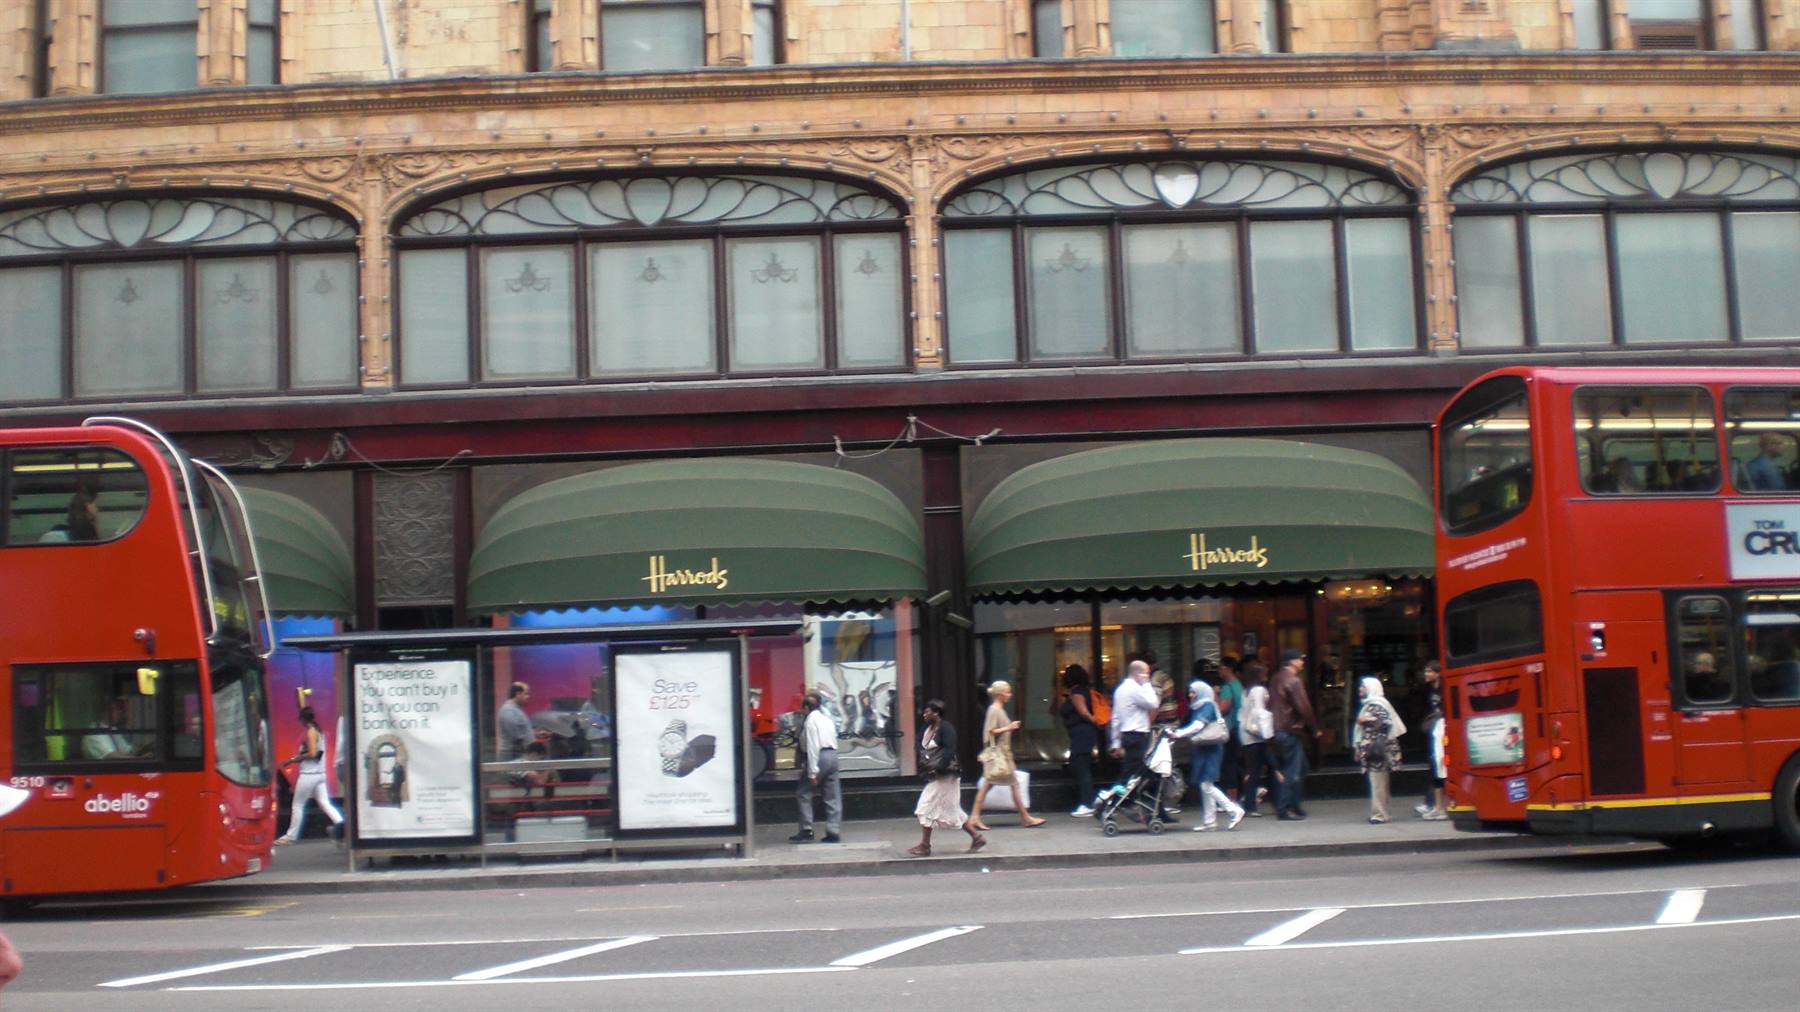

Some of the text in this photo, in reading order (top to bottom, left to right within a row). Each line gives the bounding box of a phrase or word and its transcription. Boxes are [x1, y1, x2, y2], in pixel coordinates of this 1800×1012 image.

[1754, 520, 1785, 530] TOM
[1182, 533, 1268, 571] Harrods
[641, 555, 728, 593] Harrods
[361, 667, 438, 683] Experience.
[361, 682, 458, 699] You can't buy it
[653, 679, 698, 694] Save
[362, 700, 440, 717] but you can
[362, 716, 397, 730] bank
[399, 719, 418, 729] on
[10, 776, 45, 788] 9510
[84, 793, 149, 813] abellio
